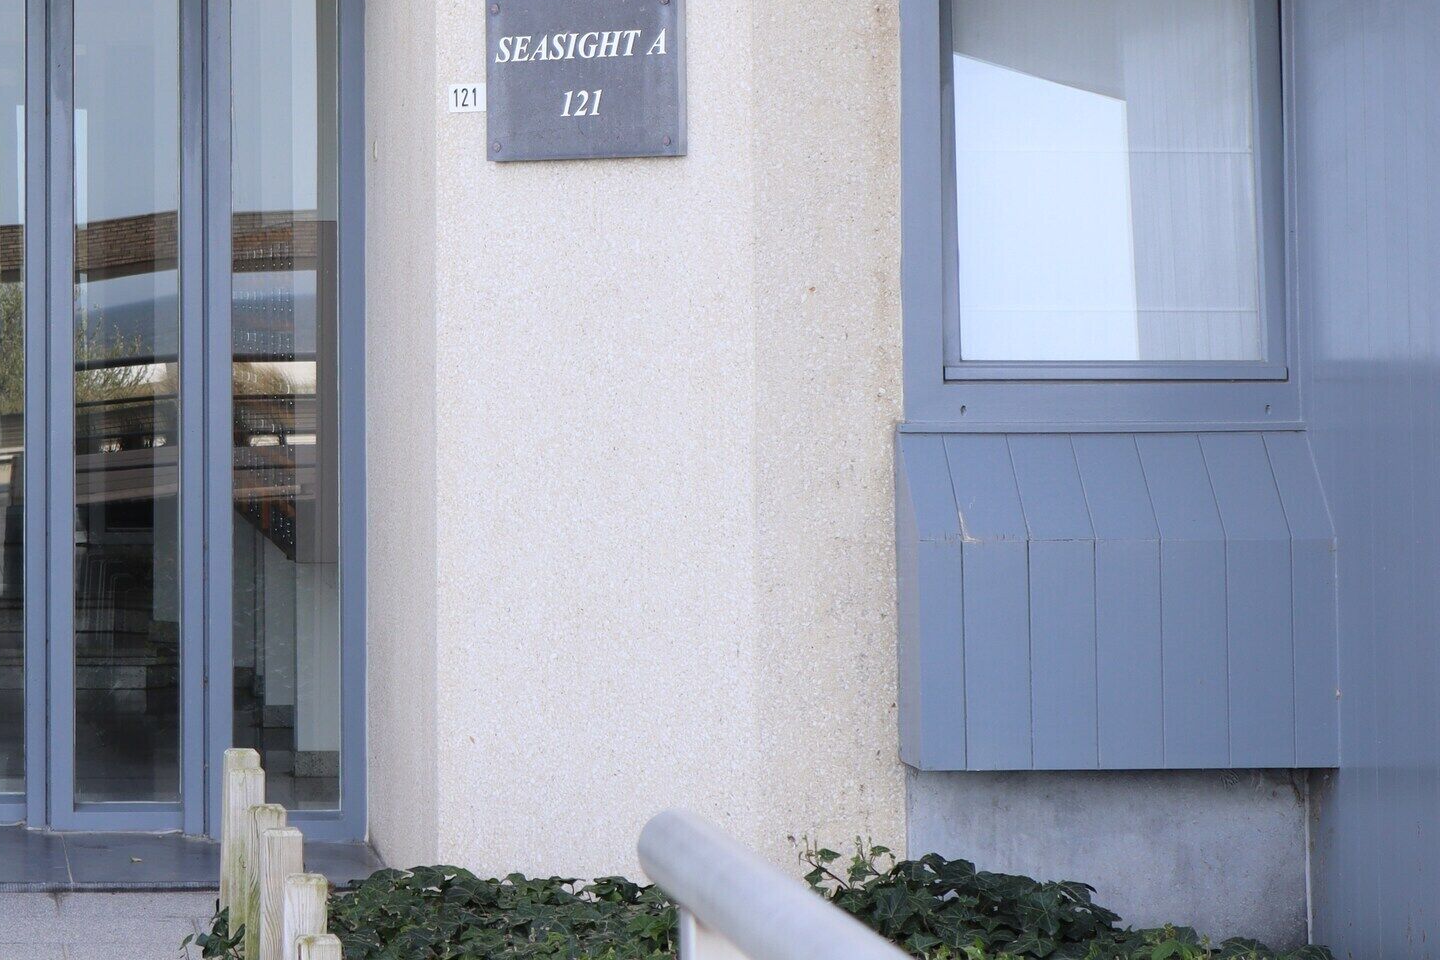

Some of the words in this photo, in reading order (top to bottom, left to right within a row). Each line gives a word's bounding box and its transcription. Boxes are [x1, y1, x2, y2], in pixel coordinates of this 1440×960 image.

[494, 29, 642, 64] SEASIGHT
[646, 27, 667, 56] A
[453, 87, 477, 107] 121
[560, 89, 603, 117] 121
